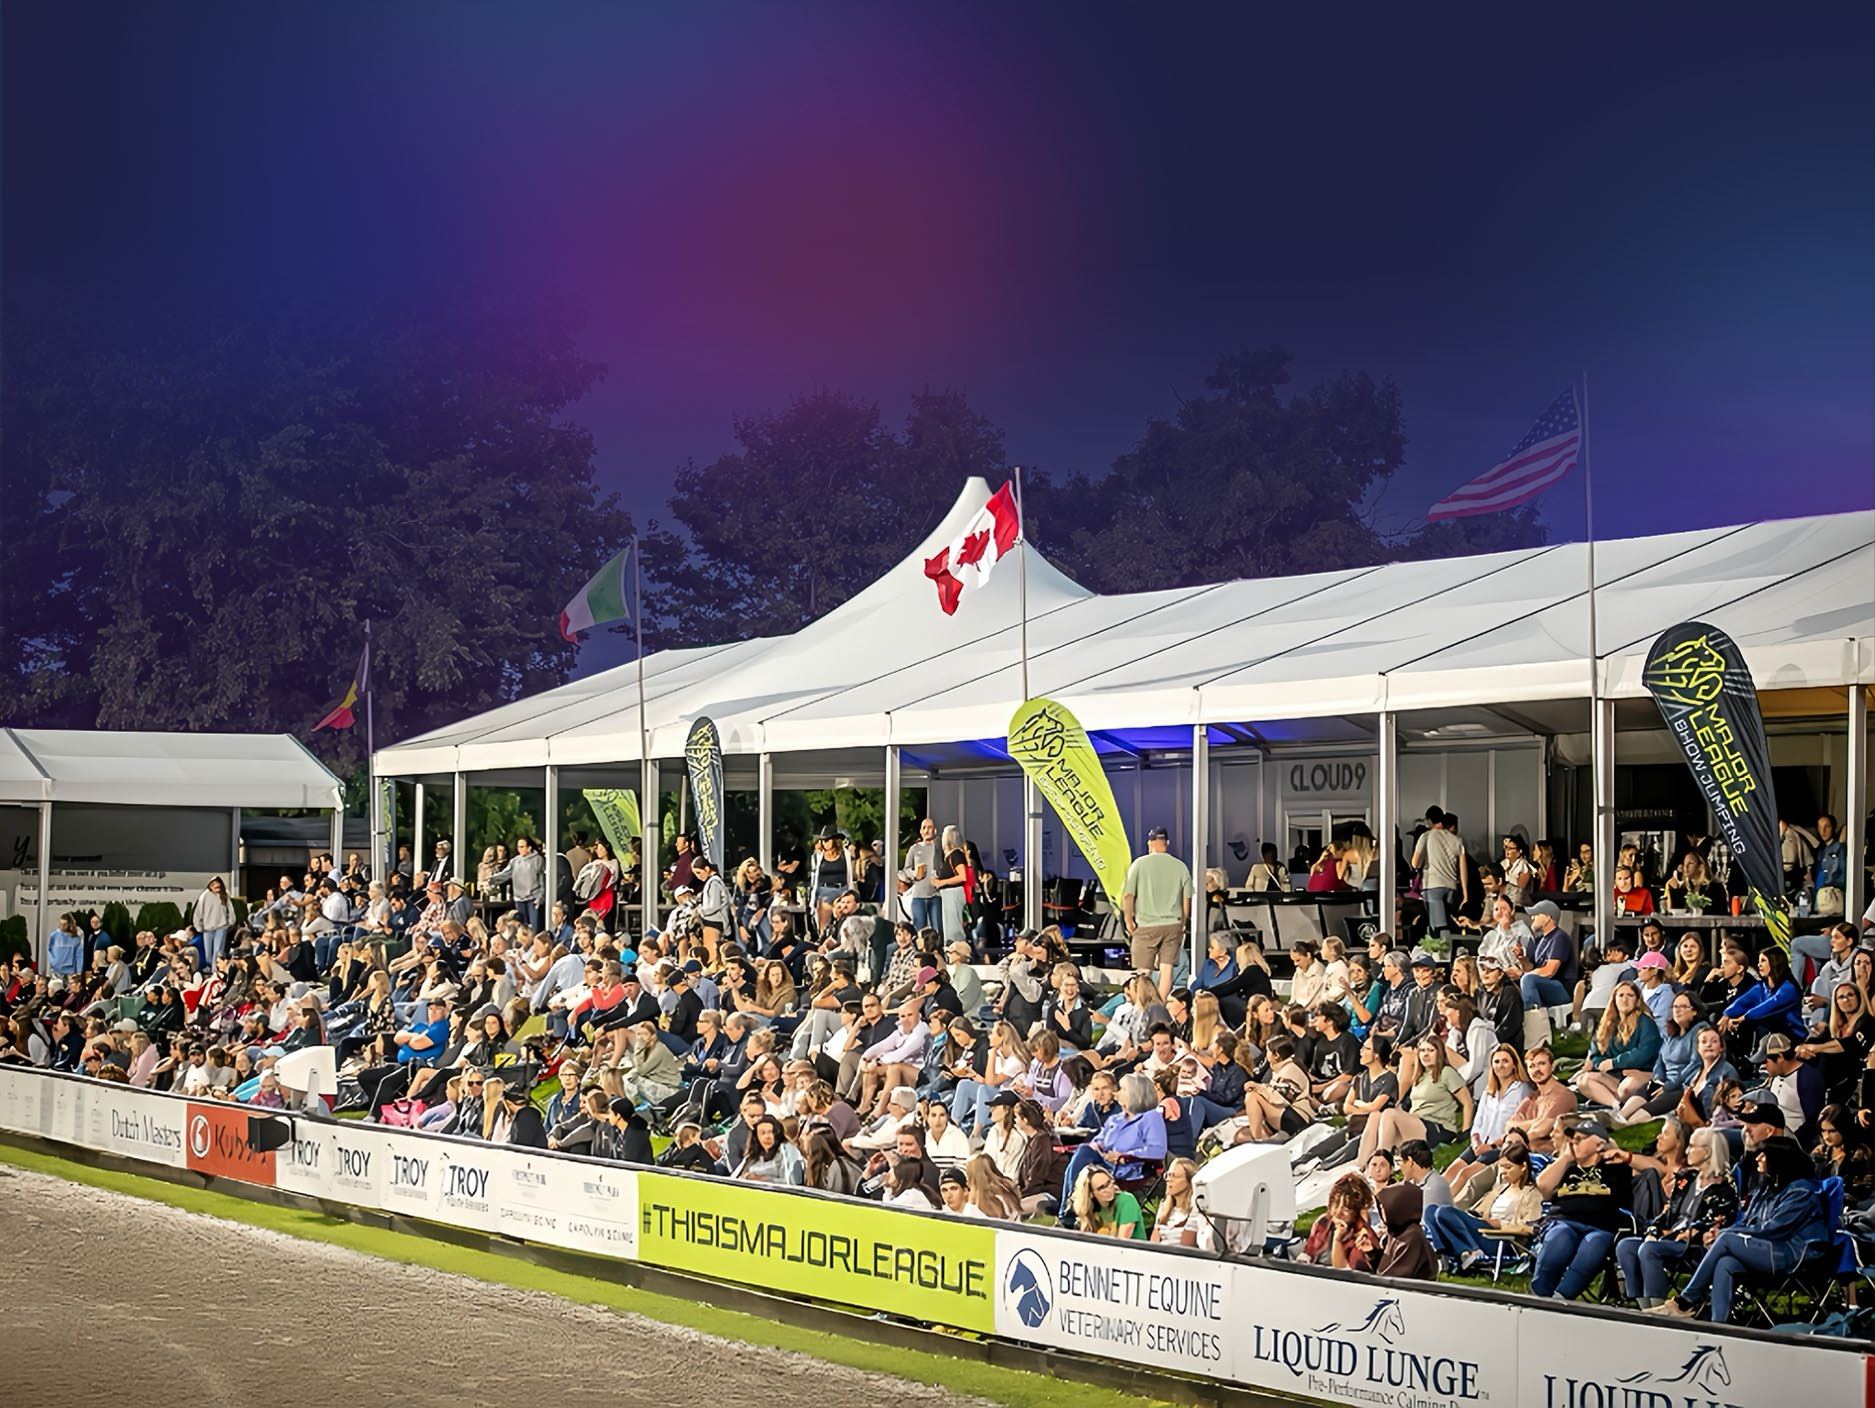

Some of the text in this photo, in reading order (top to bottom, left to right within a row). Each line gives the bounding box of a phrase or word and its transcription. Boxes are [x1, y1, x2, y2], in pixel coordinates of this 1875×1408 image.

[1290, 762, 1366, 792] CLOUD9
[1689, 710, 1748, 817] LEAGUE
[1706, 703, 1756, 793] MAJOR
[1045, 766, 1104, 840] LEAGUE
[1057, 758, 1104, 822] MAJOR
[1700, 774, 1746, 854] JUMPING
[215, 1124, 267, 1164] Kub
[337, 1147, 371, 1177] TROY
[393, 1154, 429, 1187] TROY
[449, 1165, 489, 1198] TROY
[643, 1202, 987, 1300] #THISISMAJORLEAGUE
[1059, 1260, 1222, 1320] BENNETT EQUINE
[1059, 1310, 1222, 1361] VETERINARY SERVICES
[1253, 1326, 1482, 1400] LIQUID LUNGE
